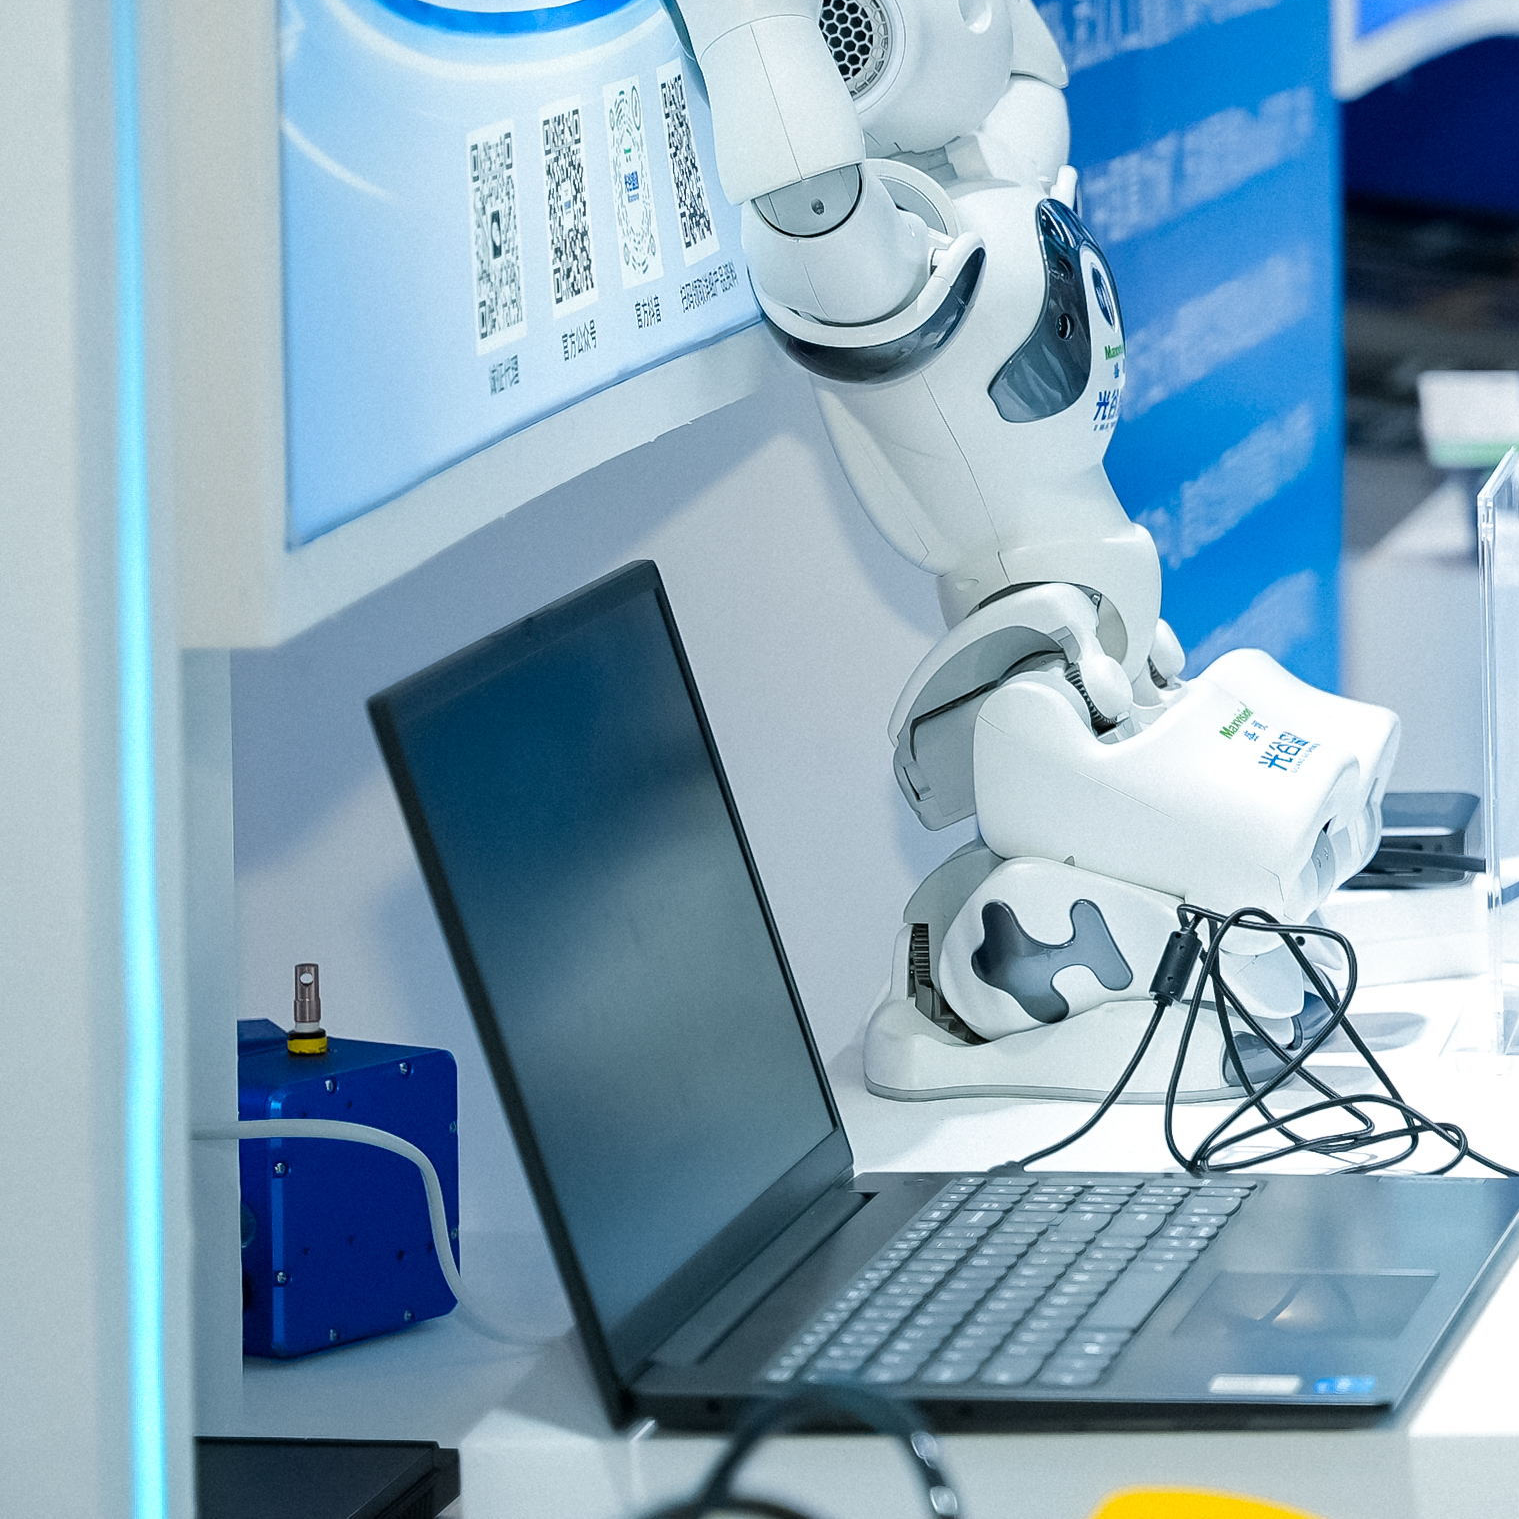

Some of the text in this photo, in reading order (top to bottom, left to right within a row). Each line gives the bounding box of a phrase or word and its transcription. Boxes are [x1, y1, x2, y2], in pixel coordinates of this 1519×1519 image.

[561, 319, 598, 363] 官方公众号
[1219, 704, 1254, 740] Maxvision
